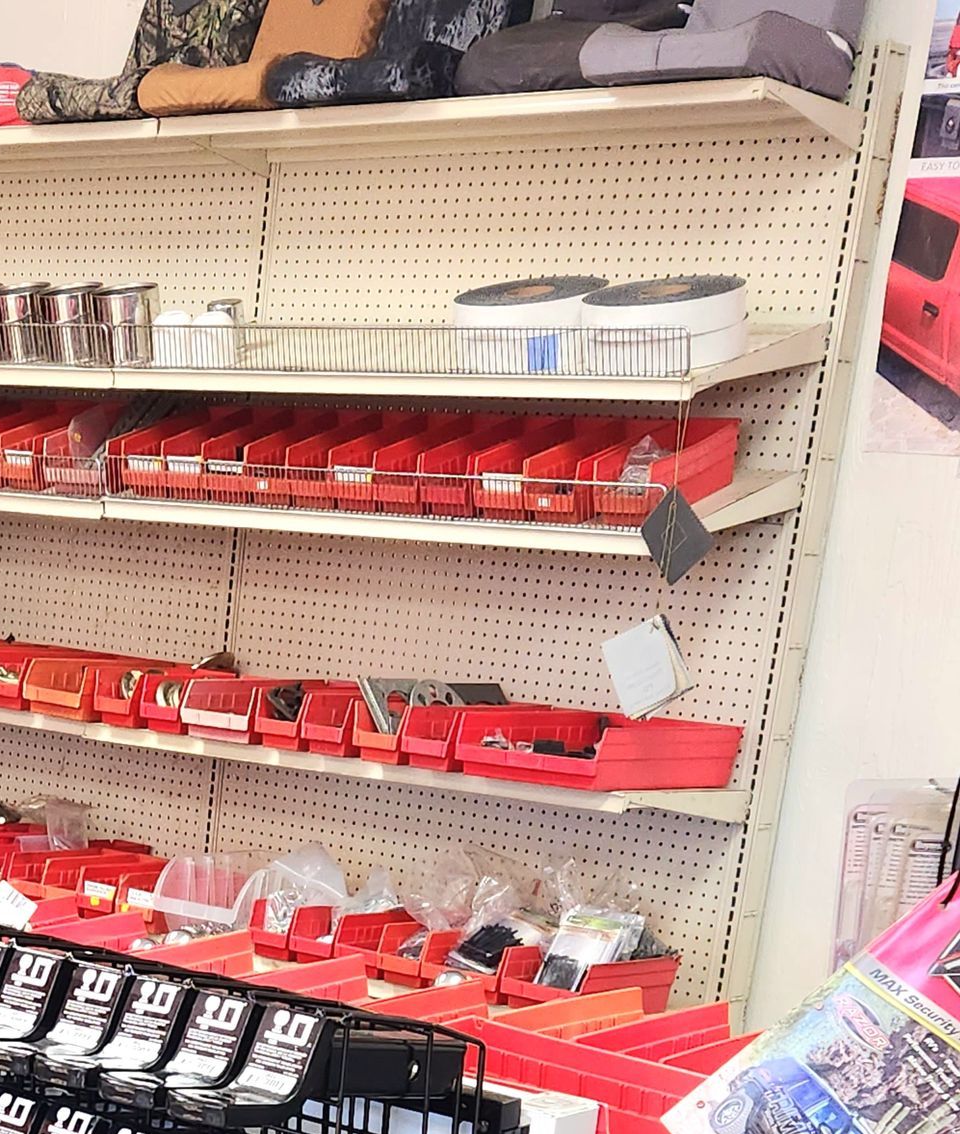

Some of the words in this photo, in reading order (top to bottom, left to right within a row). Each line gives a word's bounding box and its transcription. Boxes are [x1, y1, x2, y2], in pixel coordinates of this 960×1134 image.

[921, 162, 945, 171] EASY
[832, 994, 890, 1050] RAZOR
[869, 968, 908, 996] MAX
[904, 994, 960, 1036] Security
